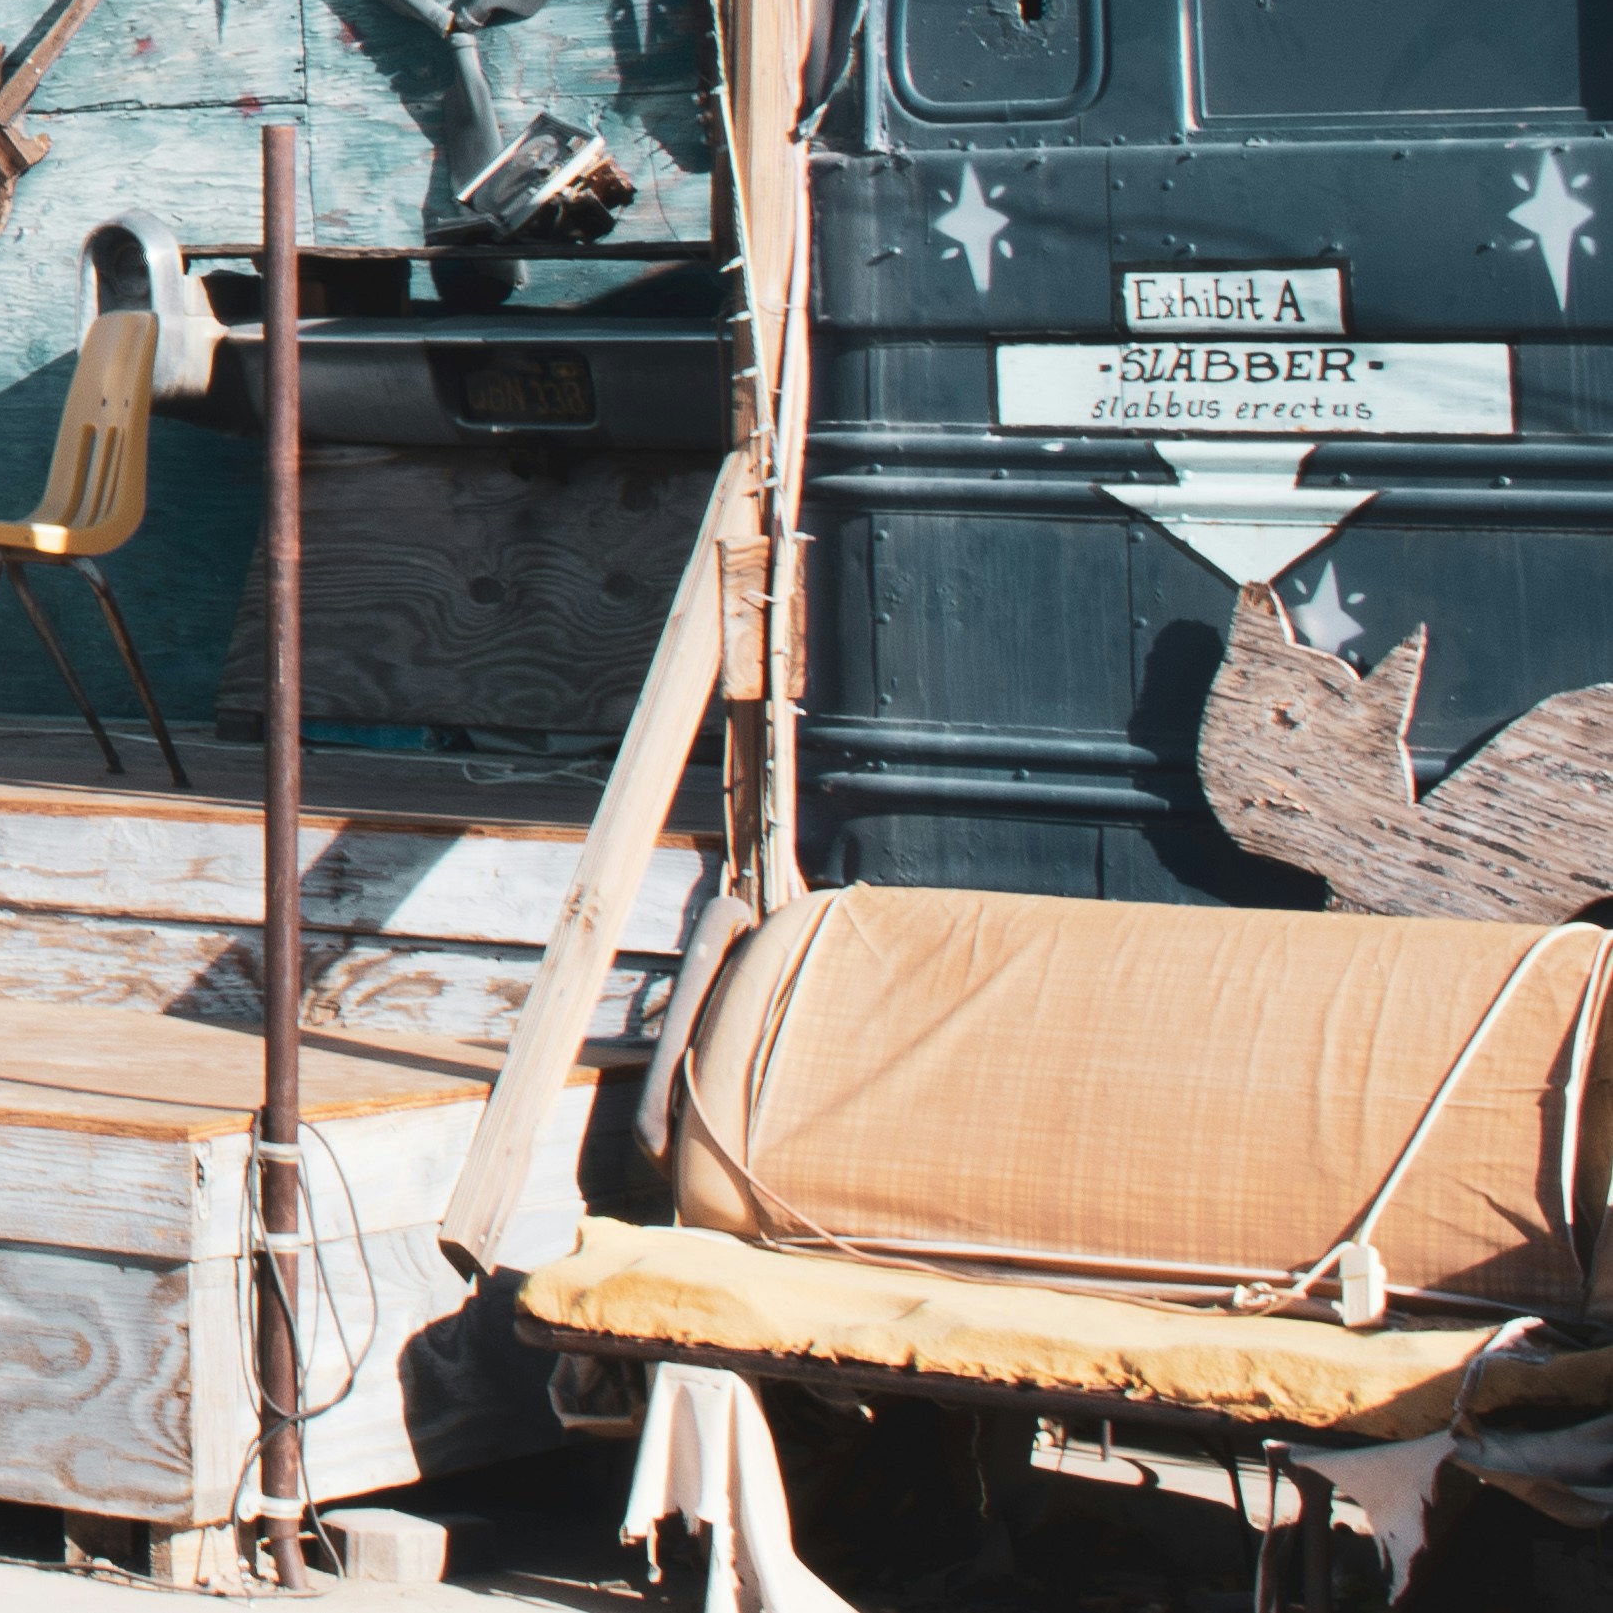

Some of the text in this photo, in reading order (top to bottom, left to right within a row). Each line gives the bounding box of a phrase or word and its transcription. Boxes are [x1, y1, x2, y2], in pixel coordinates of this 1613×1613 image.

[1134, 278, 1306, 323] Exhibit A
[1091, 391, 1373, 421] slabbus erectus
